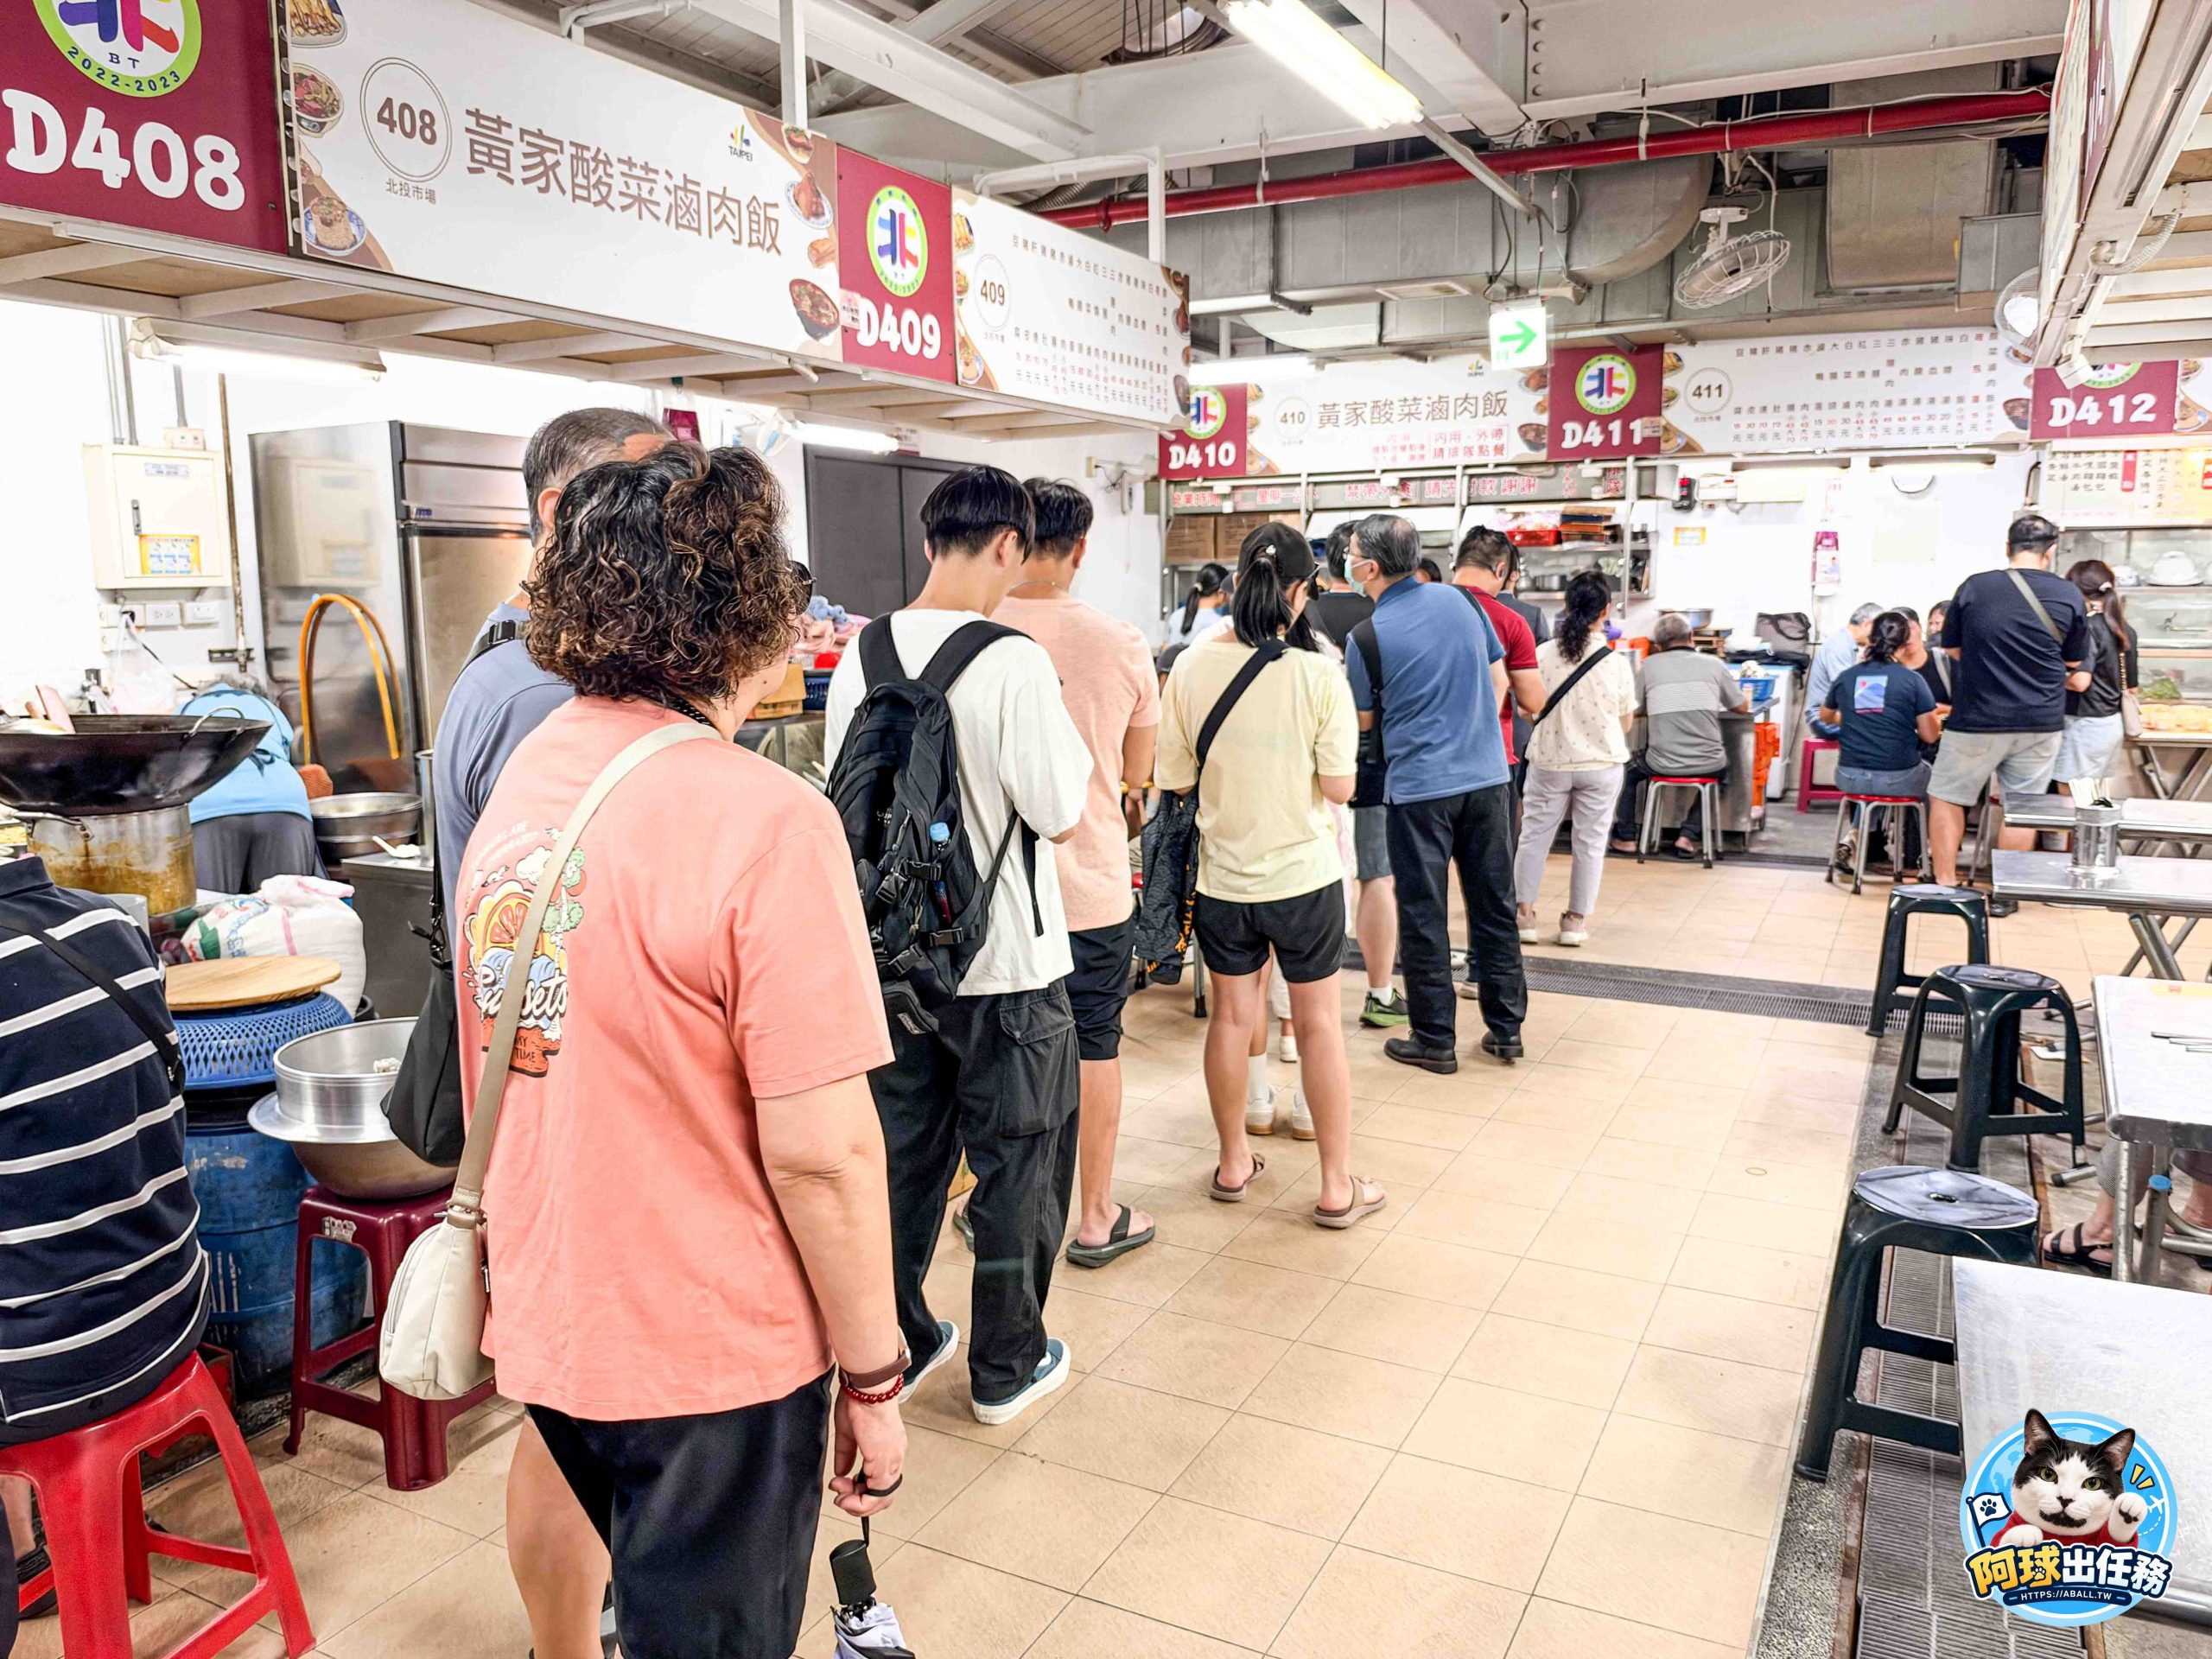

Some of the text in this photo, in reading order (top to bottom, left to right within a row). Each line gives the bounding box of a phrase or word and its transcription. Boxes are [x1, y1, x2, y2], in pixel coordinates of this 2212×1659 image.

[67, 46, 181, 92] 2022-2023
[377, 97, 437, 146] 408
[2, 88, 245, 211] D408
[728, 145, 753, 162] TAIPEI
[385, 177, 436, 205] 北投市場
[464, 107, 782, 257] 黃家酸菜滷肉飯
[981, 279, 1005, 306] 409
[856, 297, 941, 359] D409
[1693, 384, 1723, 400] 411
[1280, 411, 1306, 425] 410
[1317, 390, 1509, 429] 黃家酸菜滷肉飯
[2048, 392, 2157, 428] D412
[1560, 418, 1643, 449] D411
[1168, 441, 1236, 470] D410
